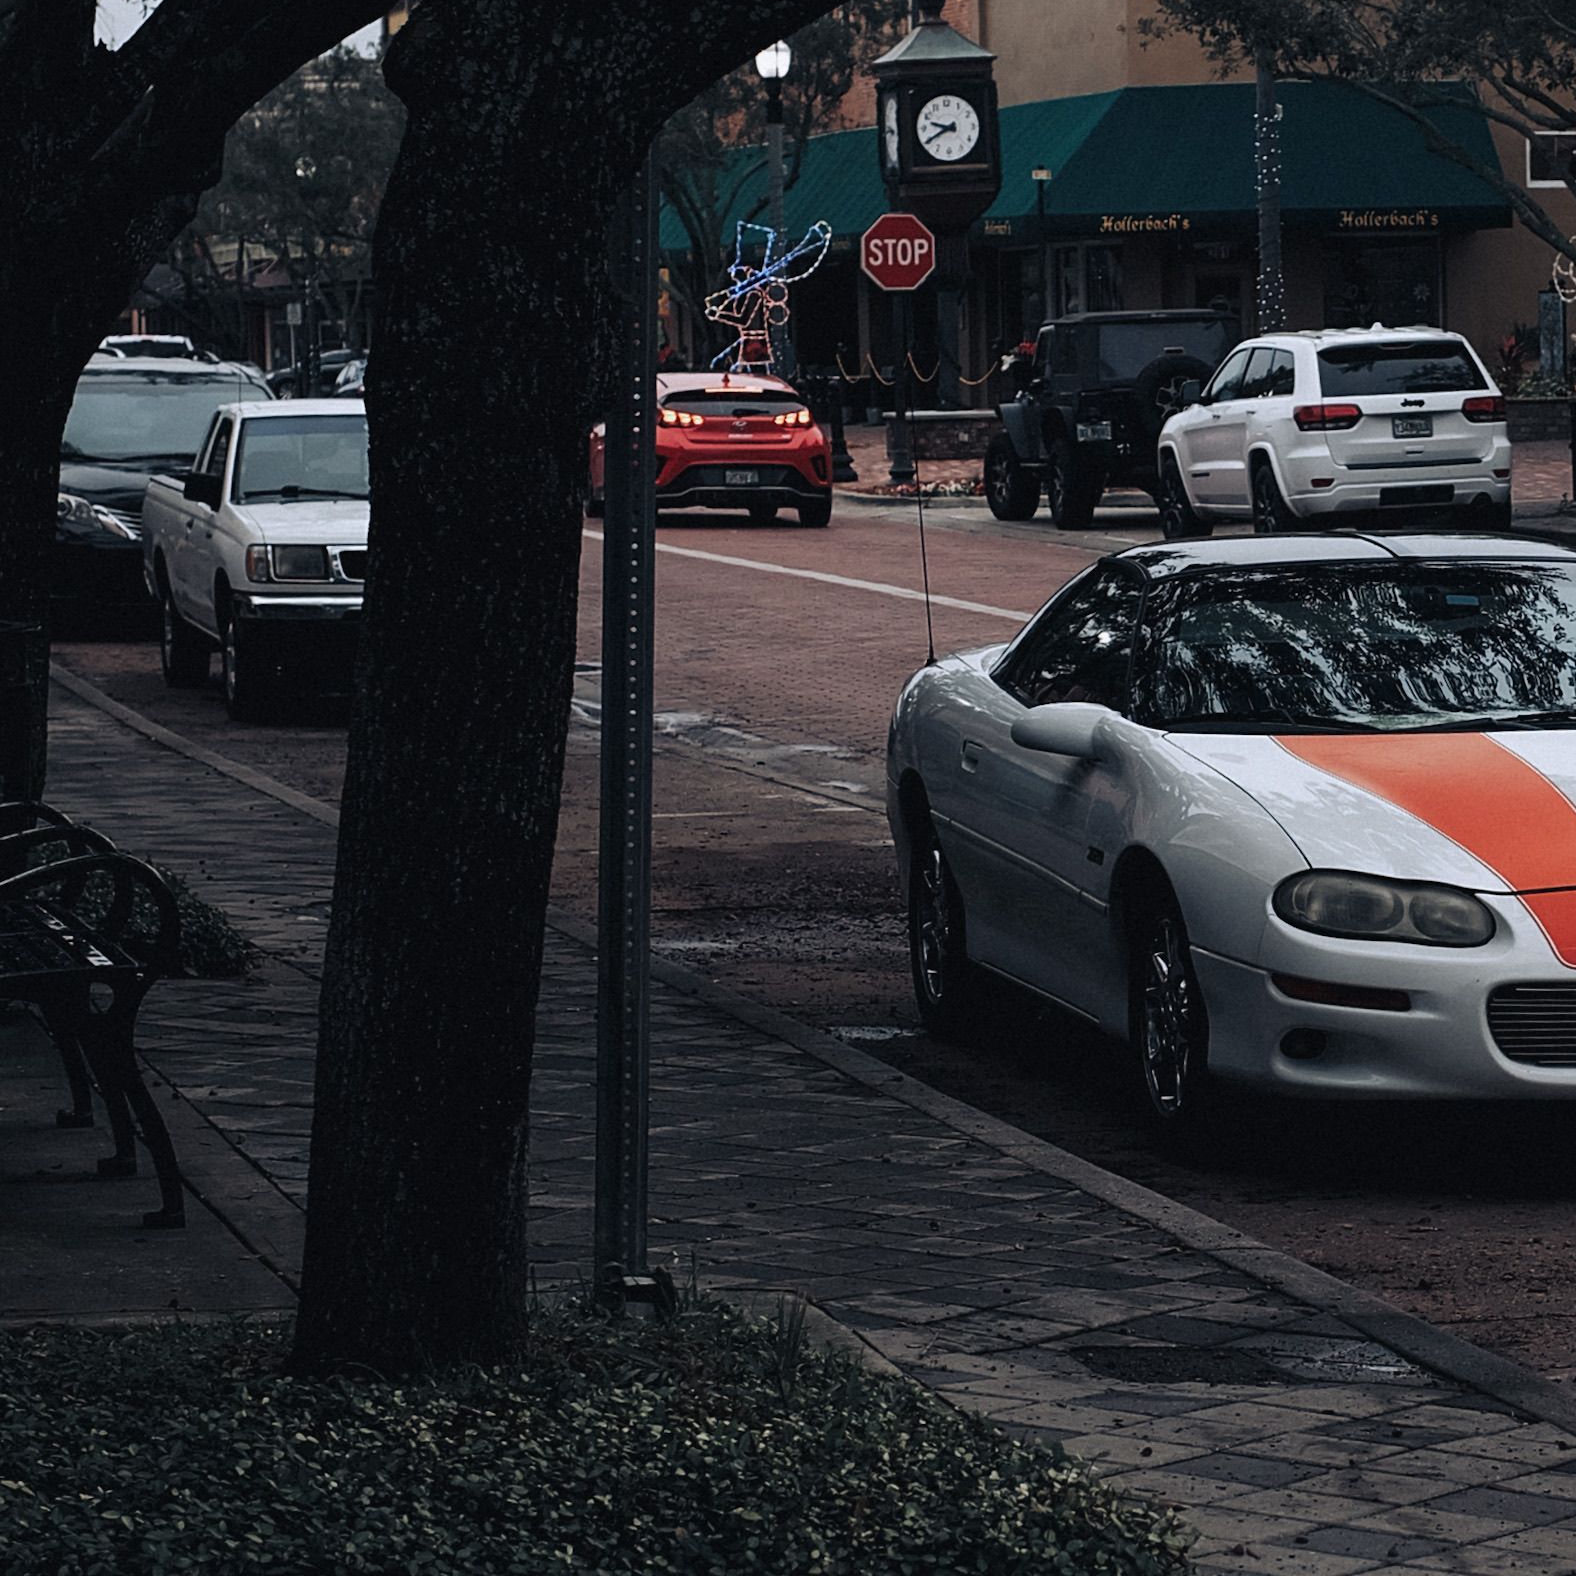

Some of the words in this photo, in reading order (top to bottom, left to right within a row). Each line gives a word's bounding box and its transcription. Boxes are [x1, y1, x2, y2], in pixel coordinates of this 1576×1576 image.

[1100, 213, 1191, 233] Hollerbach's
[1339, 209, 1440, 228] Hollerbach's
[868, 237, 930, 267] STOP
